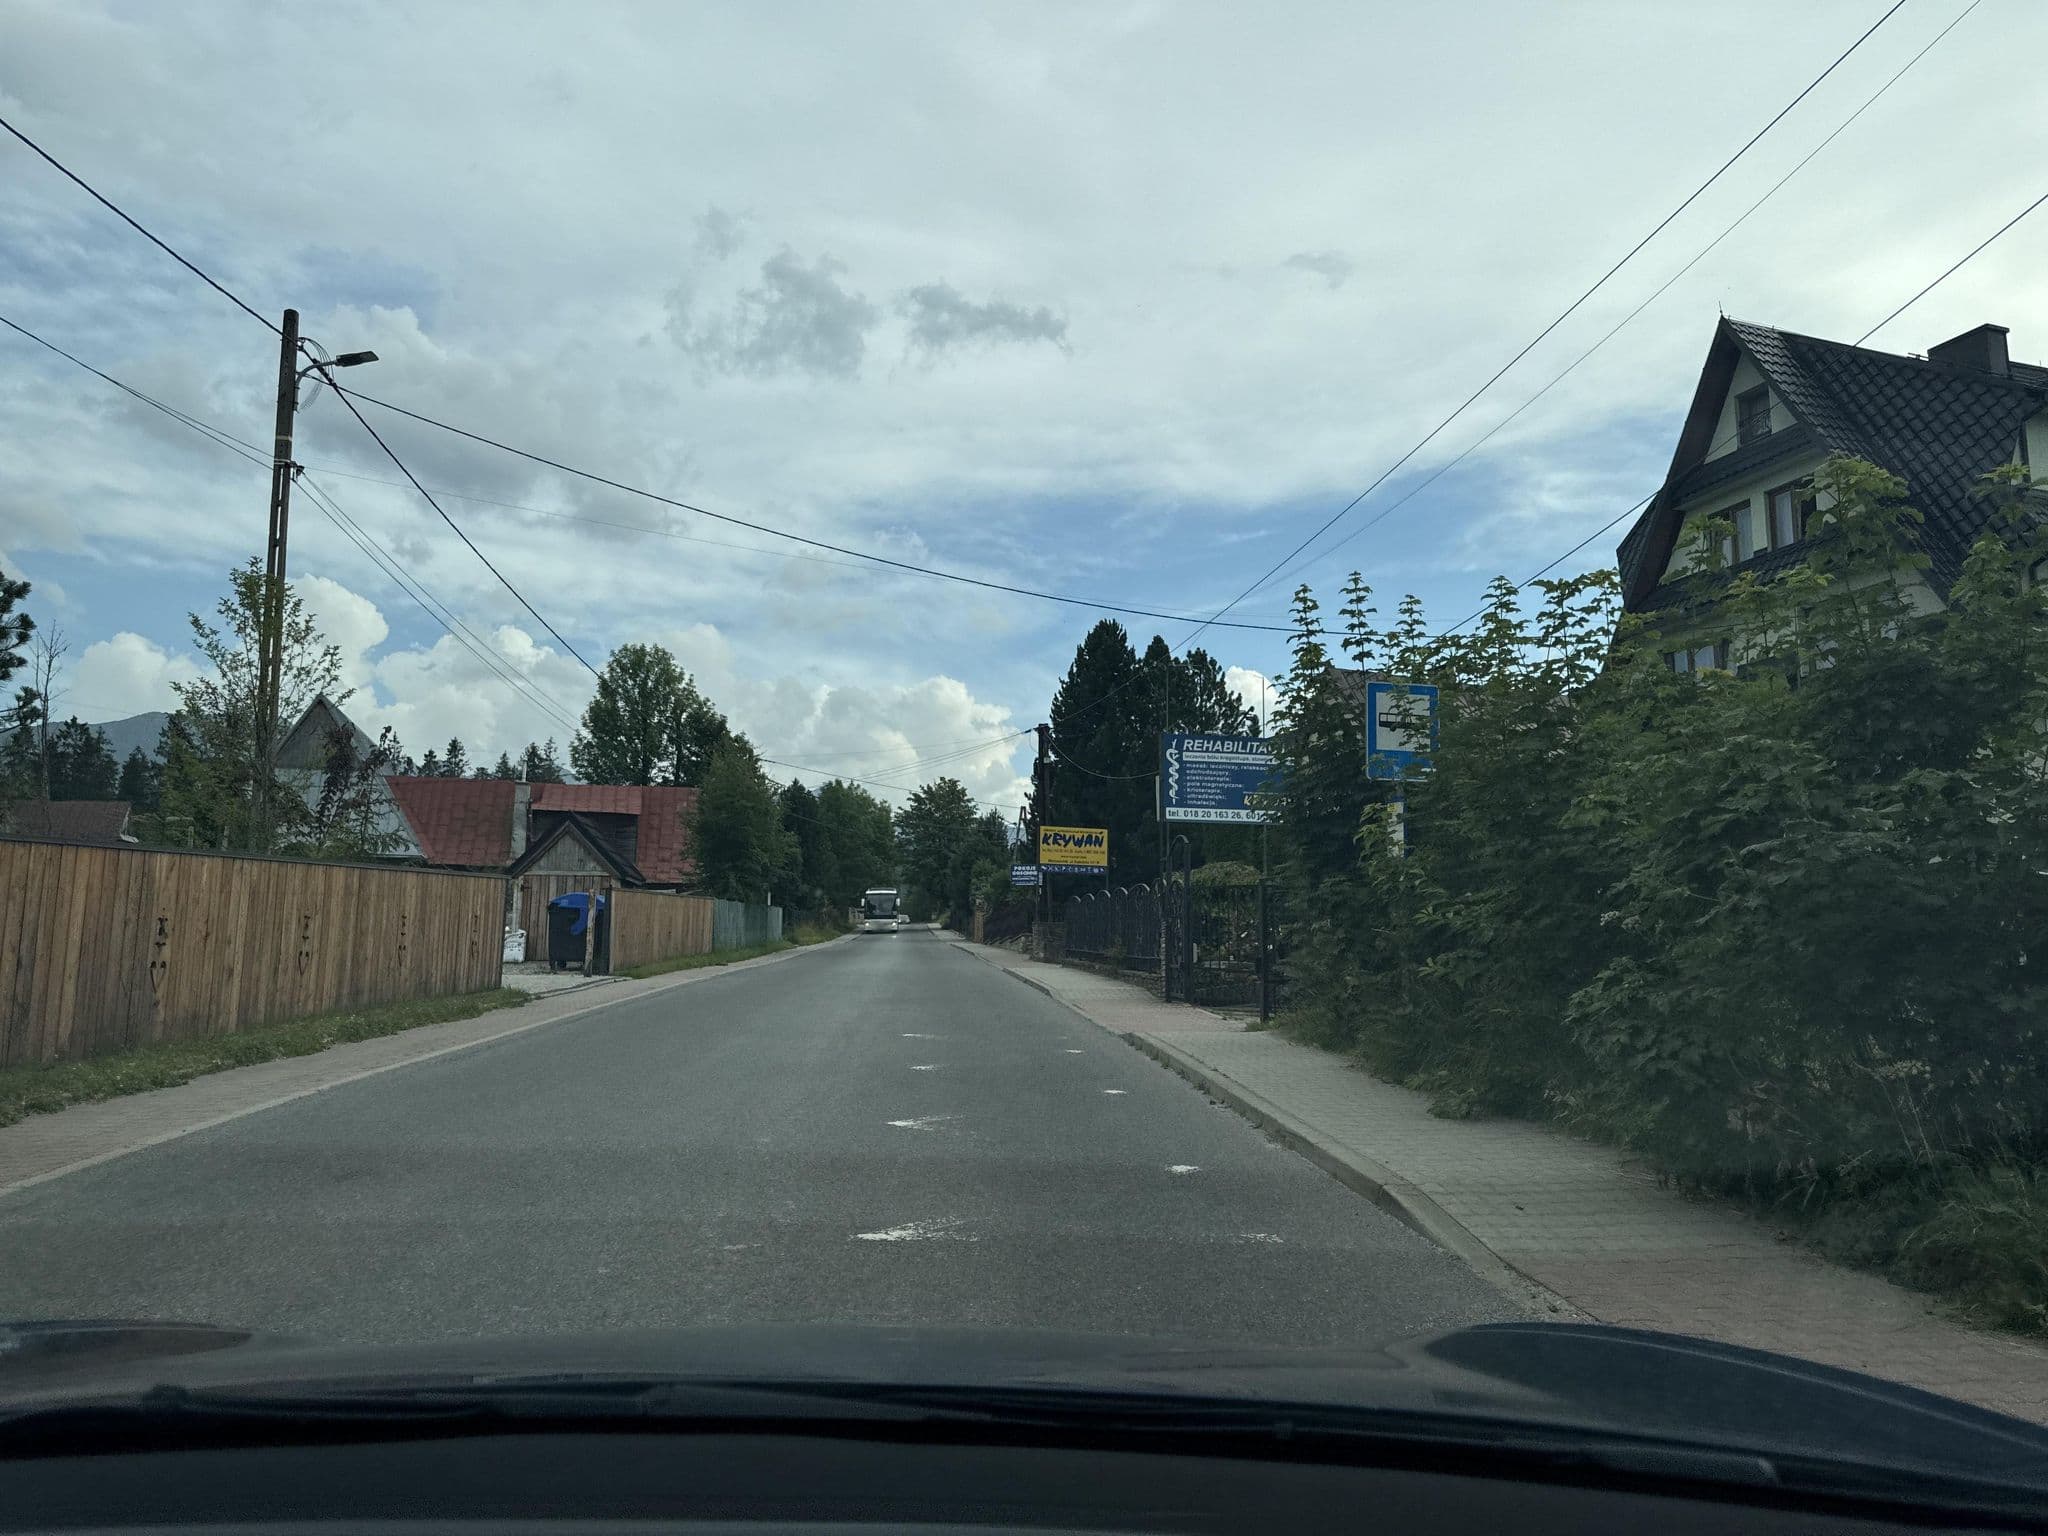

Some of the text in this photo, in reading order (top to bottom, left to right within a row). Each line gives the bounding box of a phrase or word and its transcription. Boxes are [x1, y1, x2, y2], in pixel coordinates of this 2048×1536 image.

[1183, 739, 1273, 754] REHABILITA
[1168, 809, 1181, 817] tel.
[1183, 810, 1199, 818] 018
[1215, 811, 1229, 819] 163
[1042, 831, 1104, 848] KRYWAŃ
